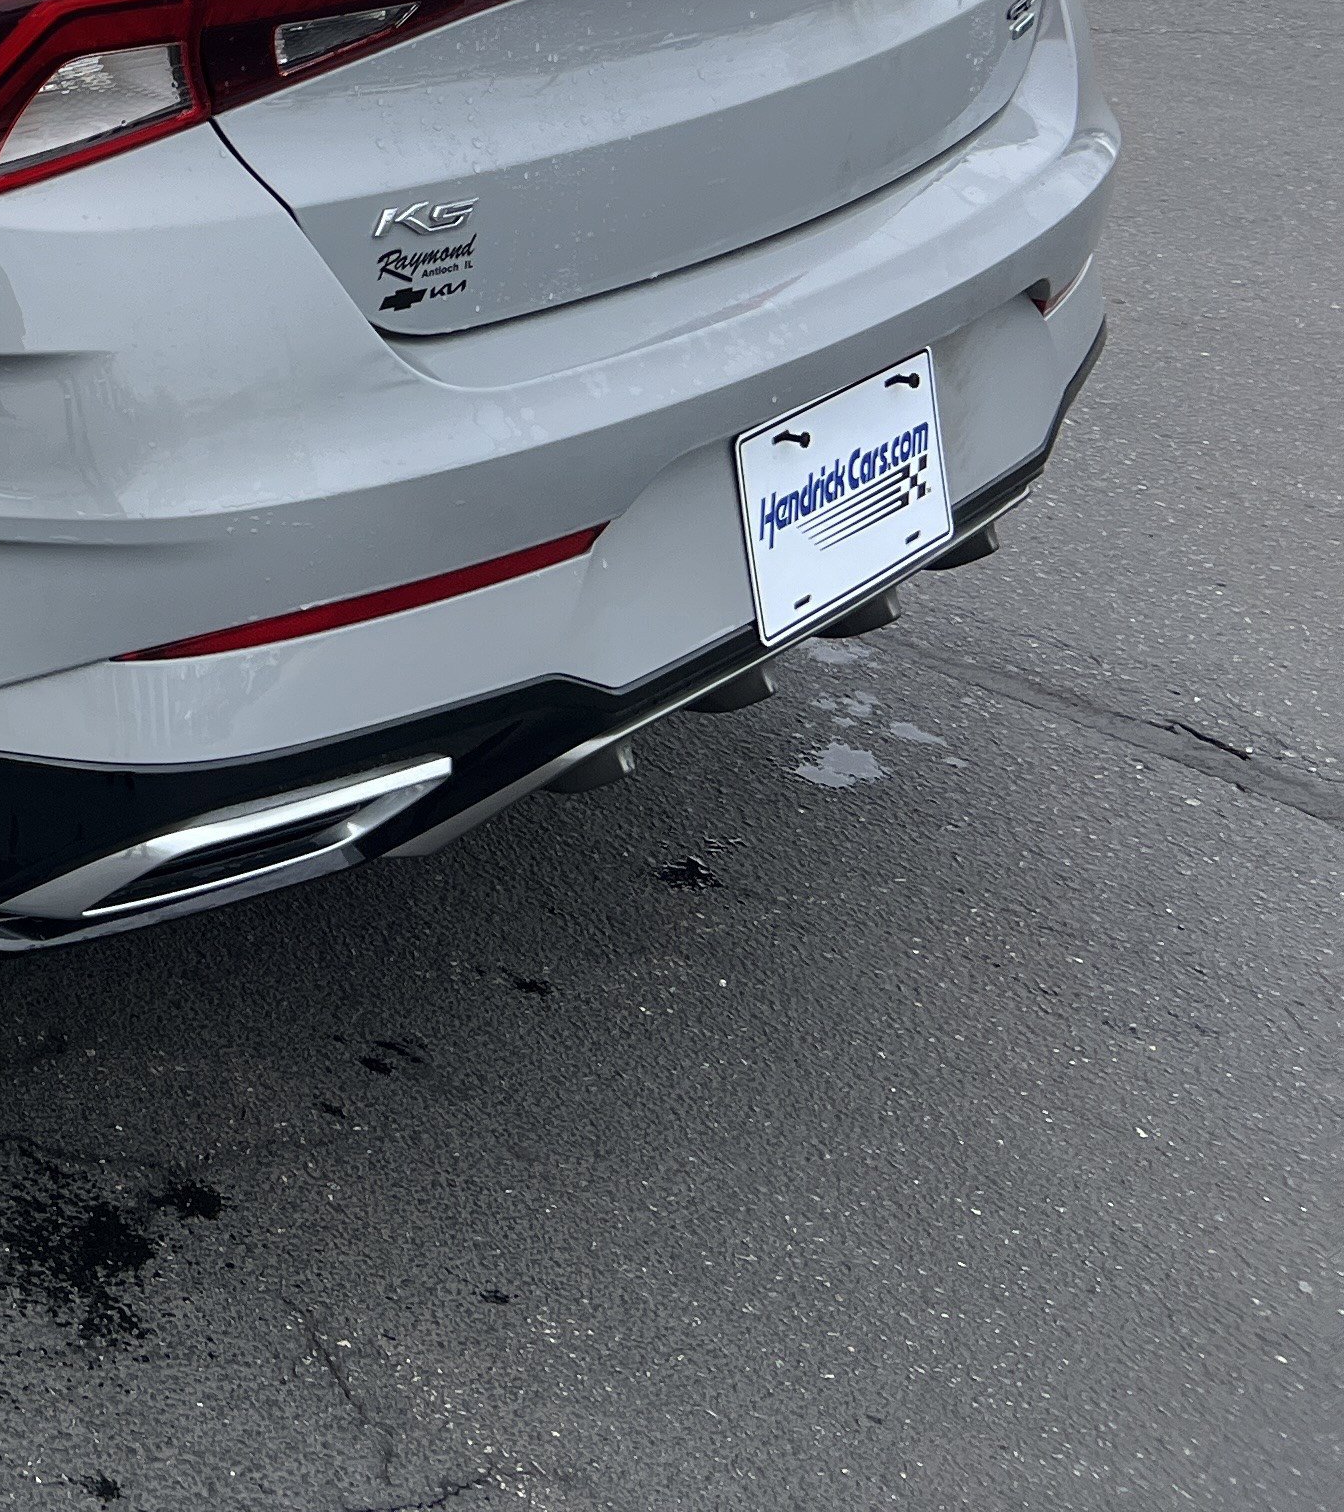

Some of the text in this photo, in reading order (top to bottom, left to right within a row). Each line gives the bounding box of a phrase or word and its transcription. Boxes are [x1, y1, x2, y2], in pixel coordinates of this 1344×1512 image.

[372, 197, 480, 239] K5
[377, 233, 478, 282] Raymond
[421, 260, 474, 279] Antioch IL
